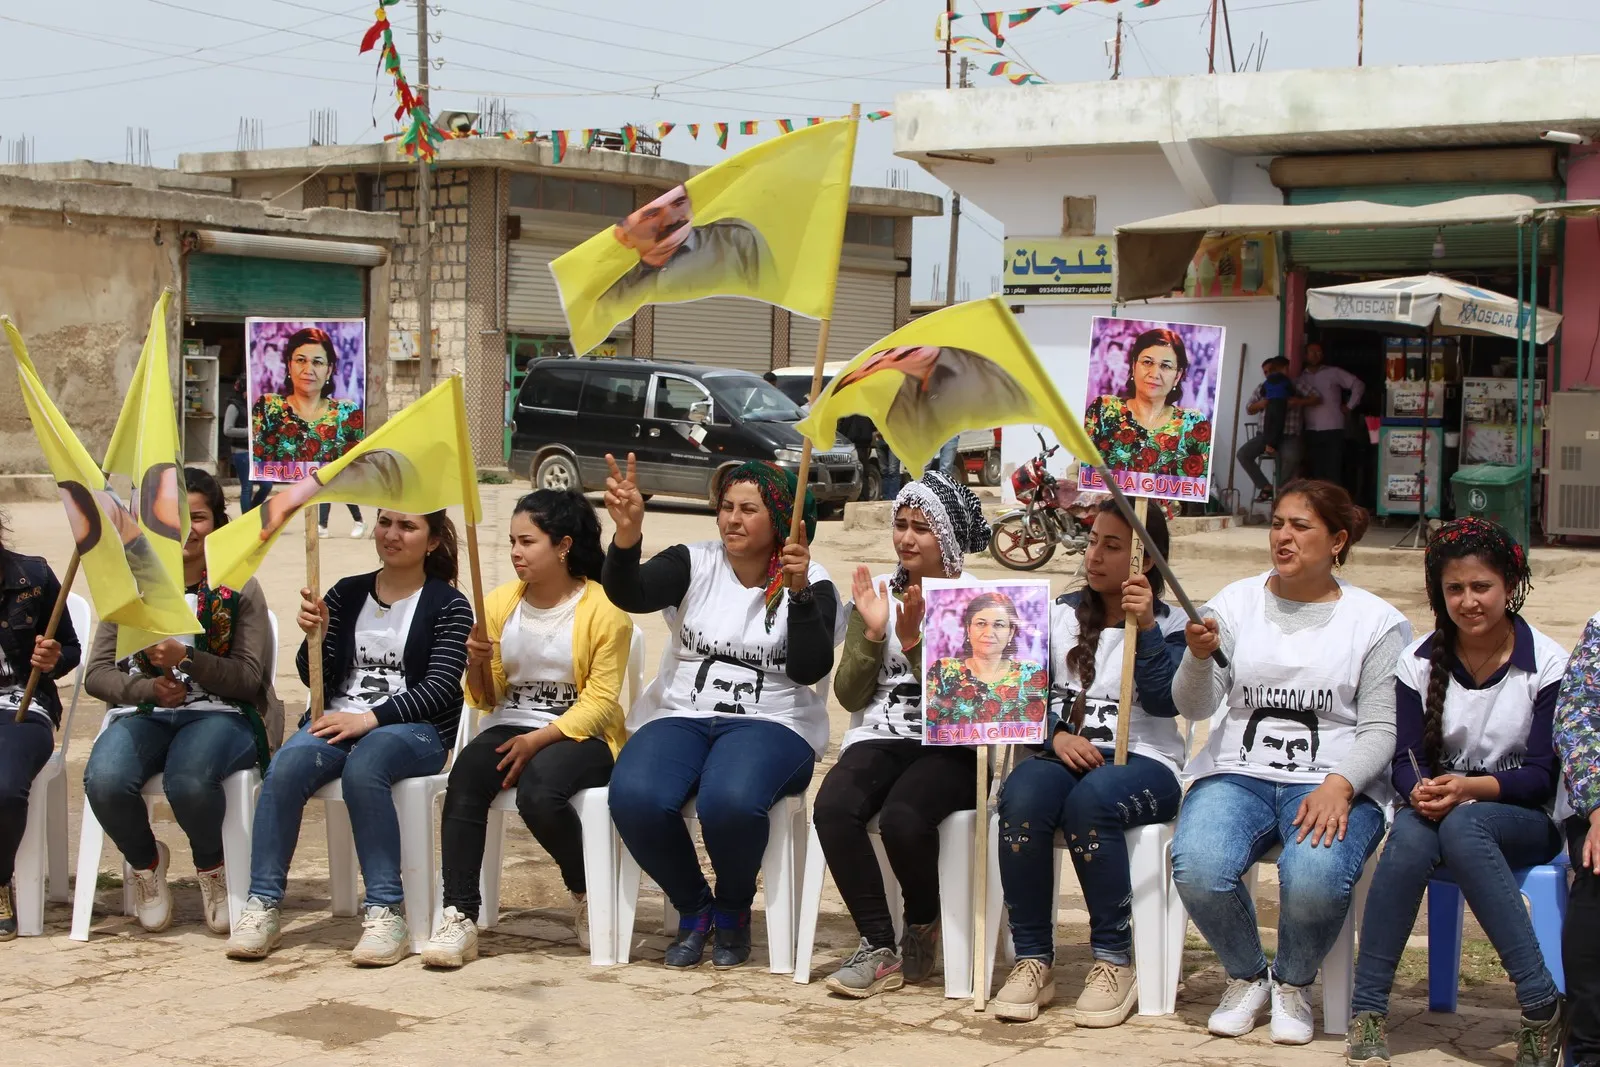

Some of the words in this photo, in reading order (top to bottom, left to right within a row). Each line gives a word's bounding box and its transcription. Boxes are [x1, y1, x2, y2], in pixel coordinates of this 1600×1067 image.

[1012, 243, 1112, 282] ثلجات
[1355, 300, 1395, 314] OSCAR
[1477, 309, 1513, 327] OSCAR
[254, 465, 305, 479] LEYLA
[1080, 471, 1136, 491] LELA
[1141, 475, 1206, 496] GÜVEN
[927, 728, 981, 742] LEYLA
